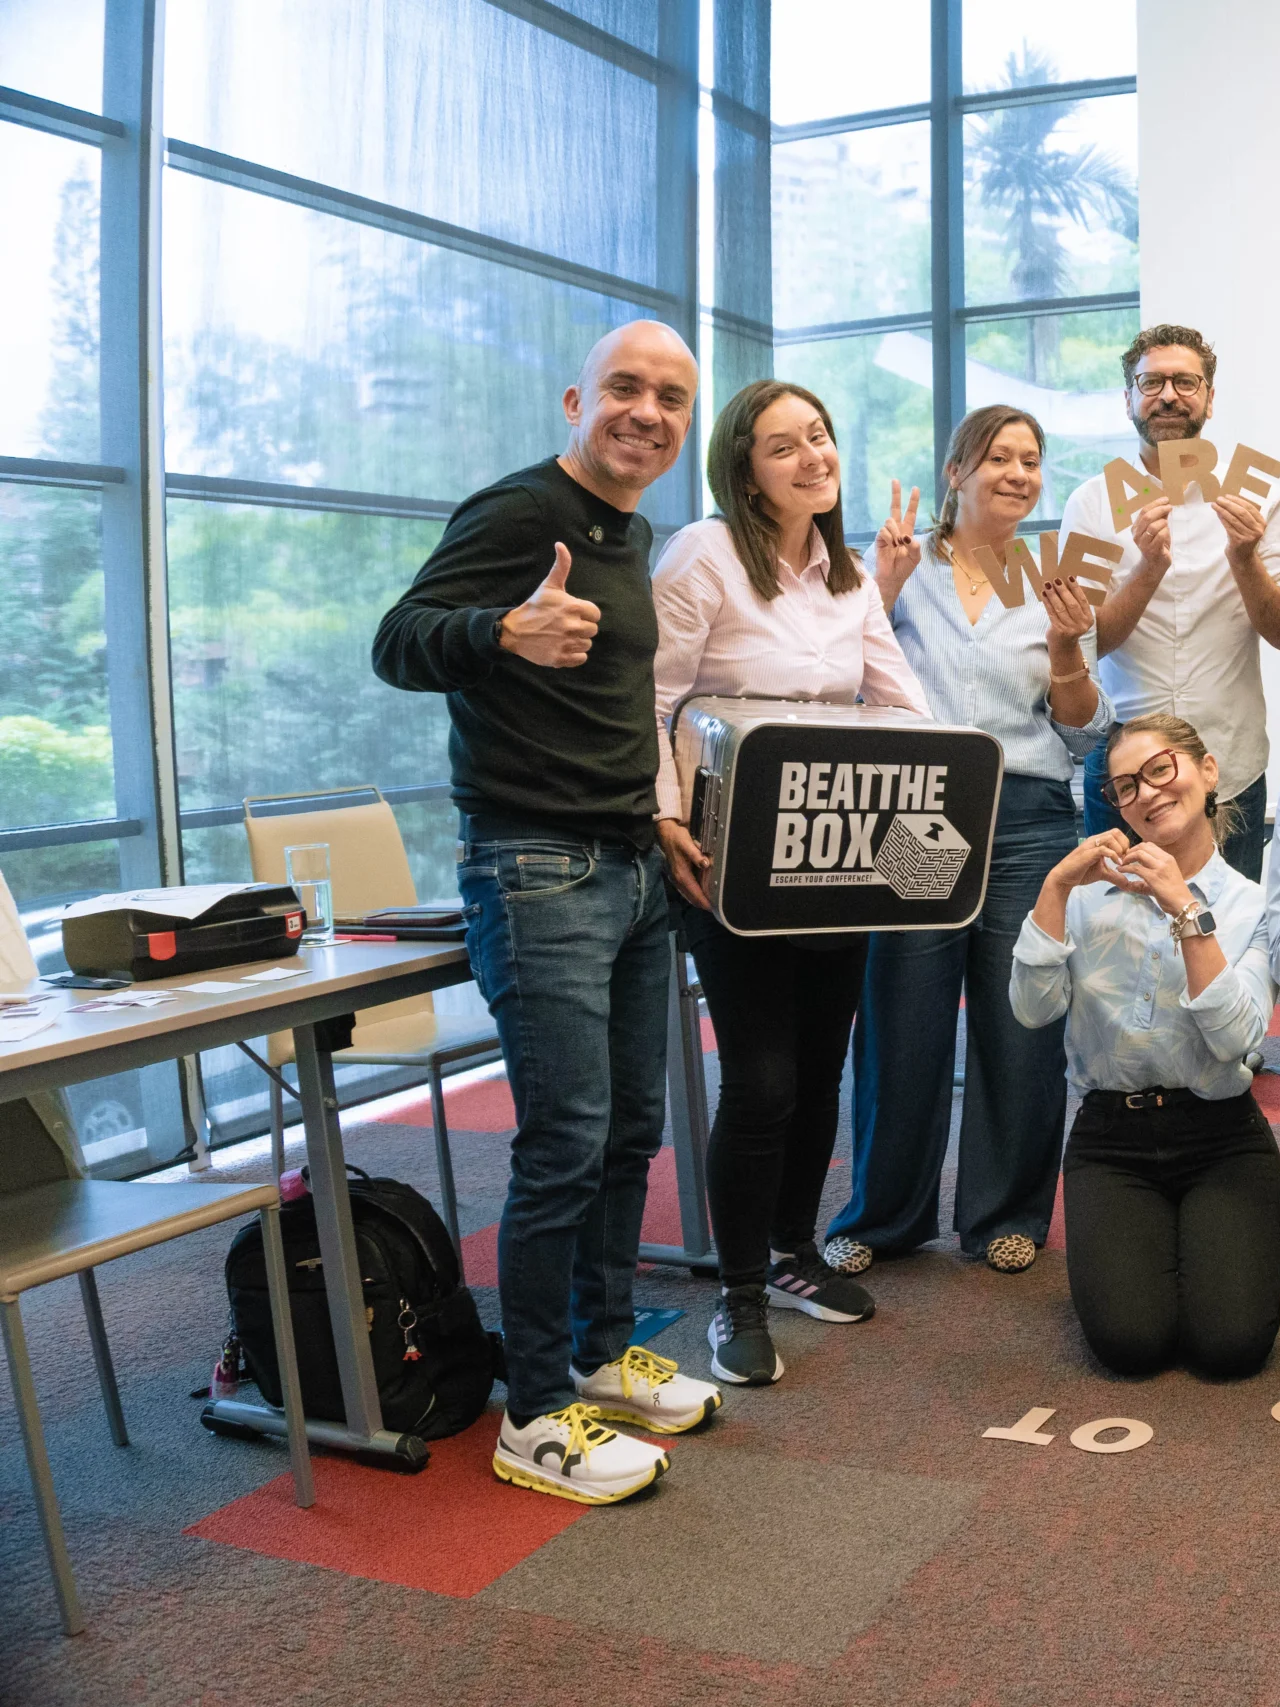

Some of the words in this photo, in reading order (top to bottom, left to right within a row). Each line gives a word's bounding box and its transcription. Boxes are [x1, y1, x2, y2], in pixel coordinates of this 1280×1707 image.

[970, 530, 1124, 609] WE
[772, 812, 879, 869] BOX
[775, 875, 803, 884] ESCAPE
[805, 875, 823, 883] YOUR
[825, 874, 873, 883] CONFERENCE!
